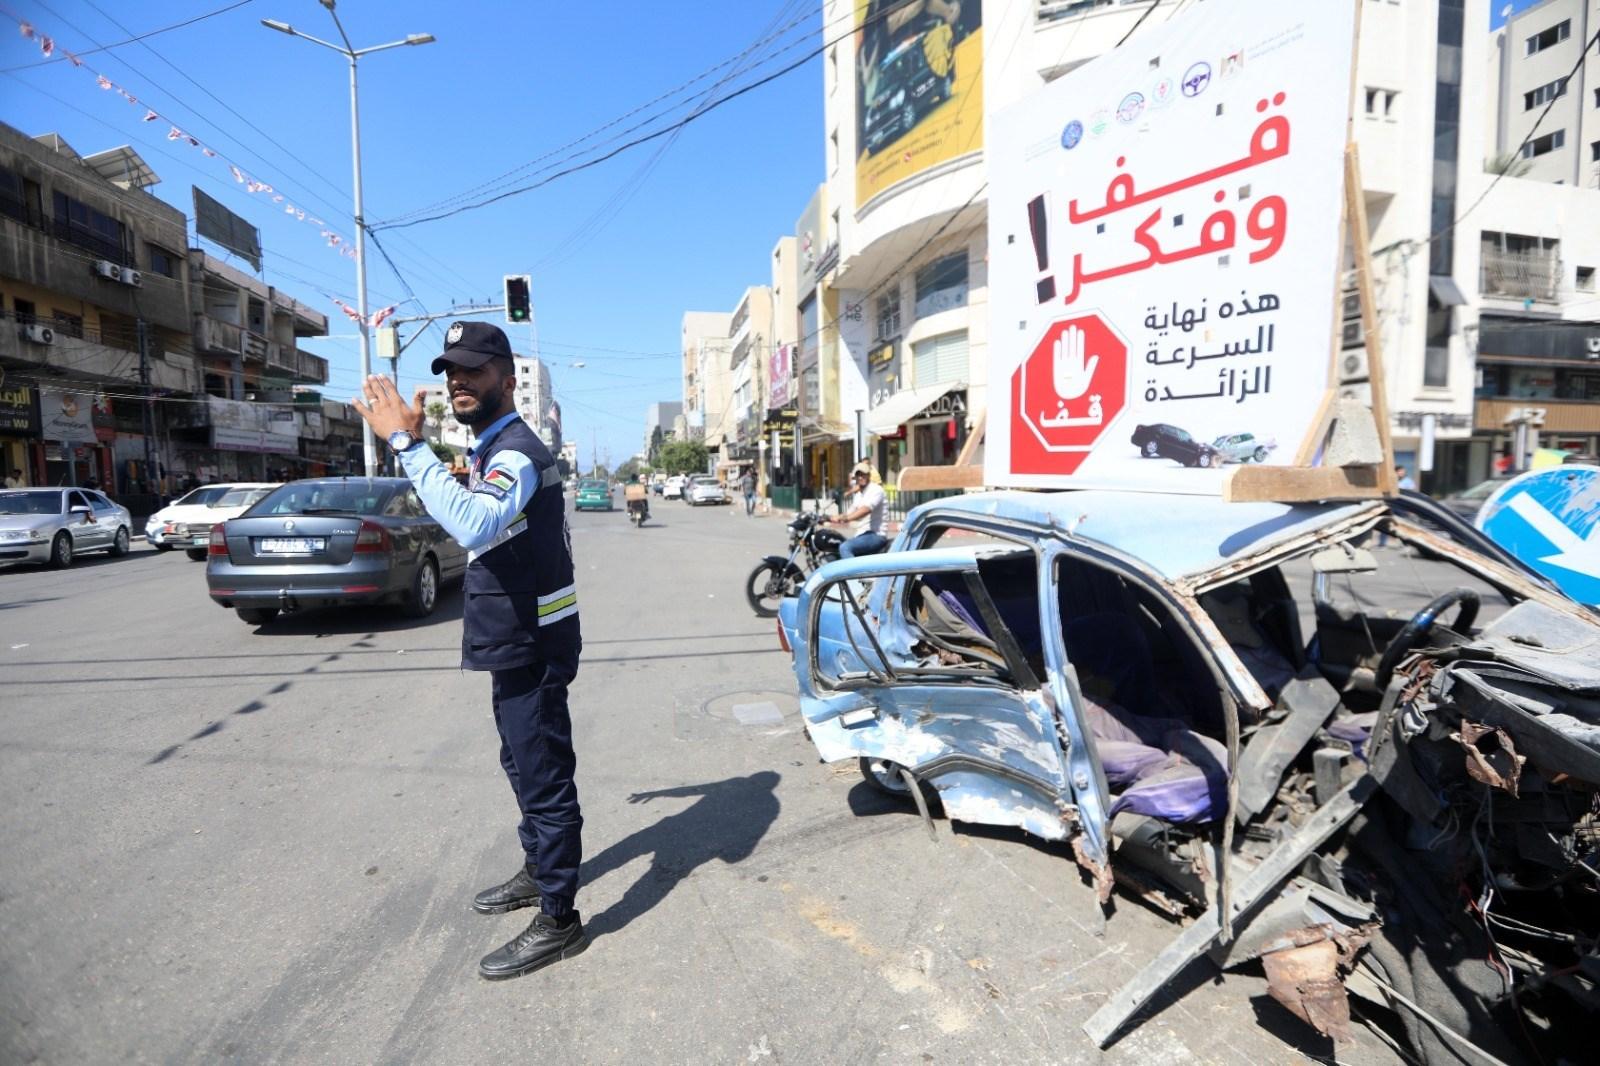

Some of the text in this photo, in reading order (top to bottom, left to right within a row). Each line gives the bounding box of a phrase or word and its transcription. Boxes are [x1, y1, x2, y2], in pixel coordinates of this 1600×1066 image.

[1069, 92, 1290, 225] قف
[1144, 289, 1279, 337] هذه نهاية
[1146, 324, 1274, 369] السرعة
[1144, 365, 1271, 404] الزائدة
[1040, 391, 1103, 428] قف
